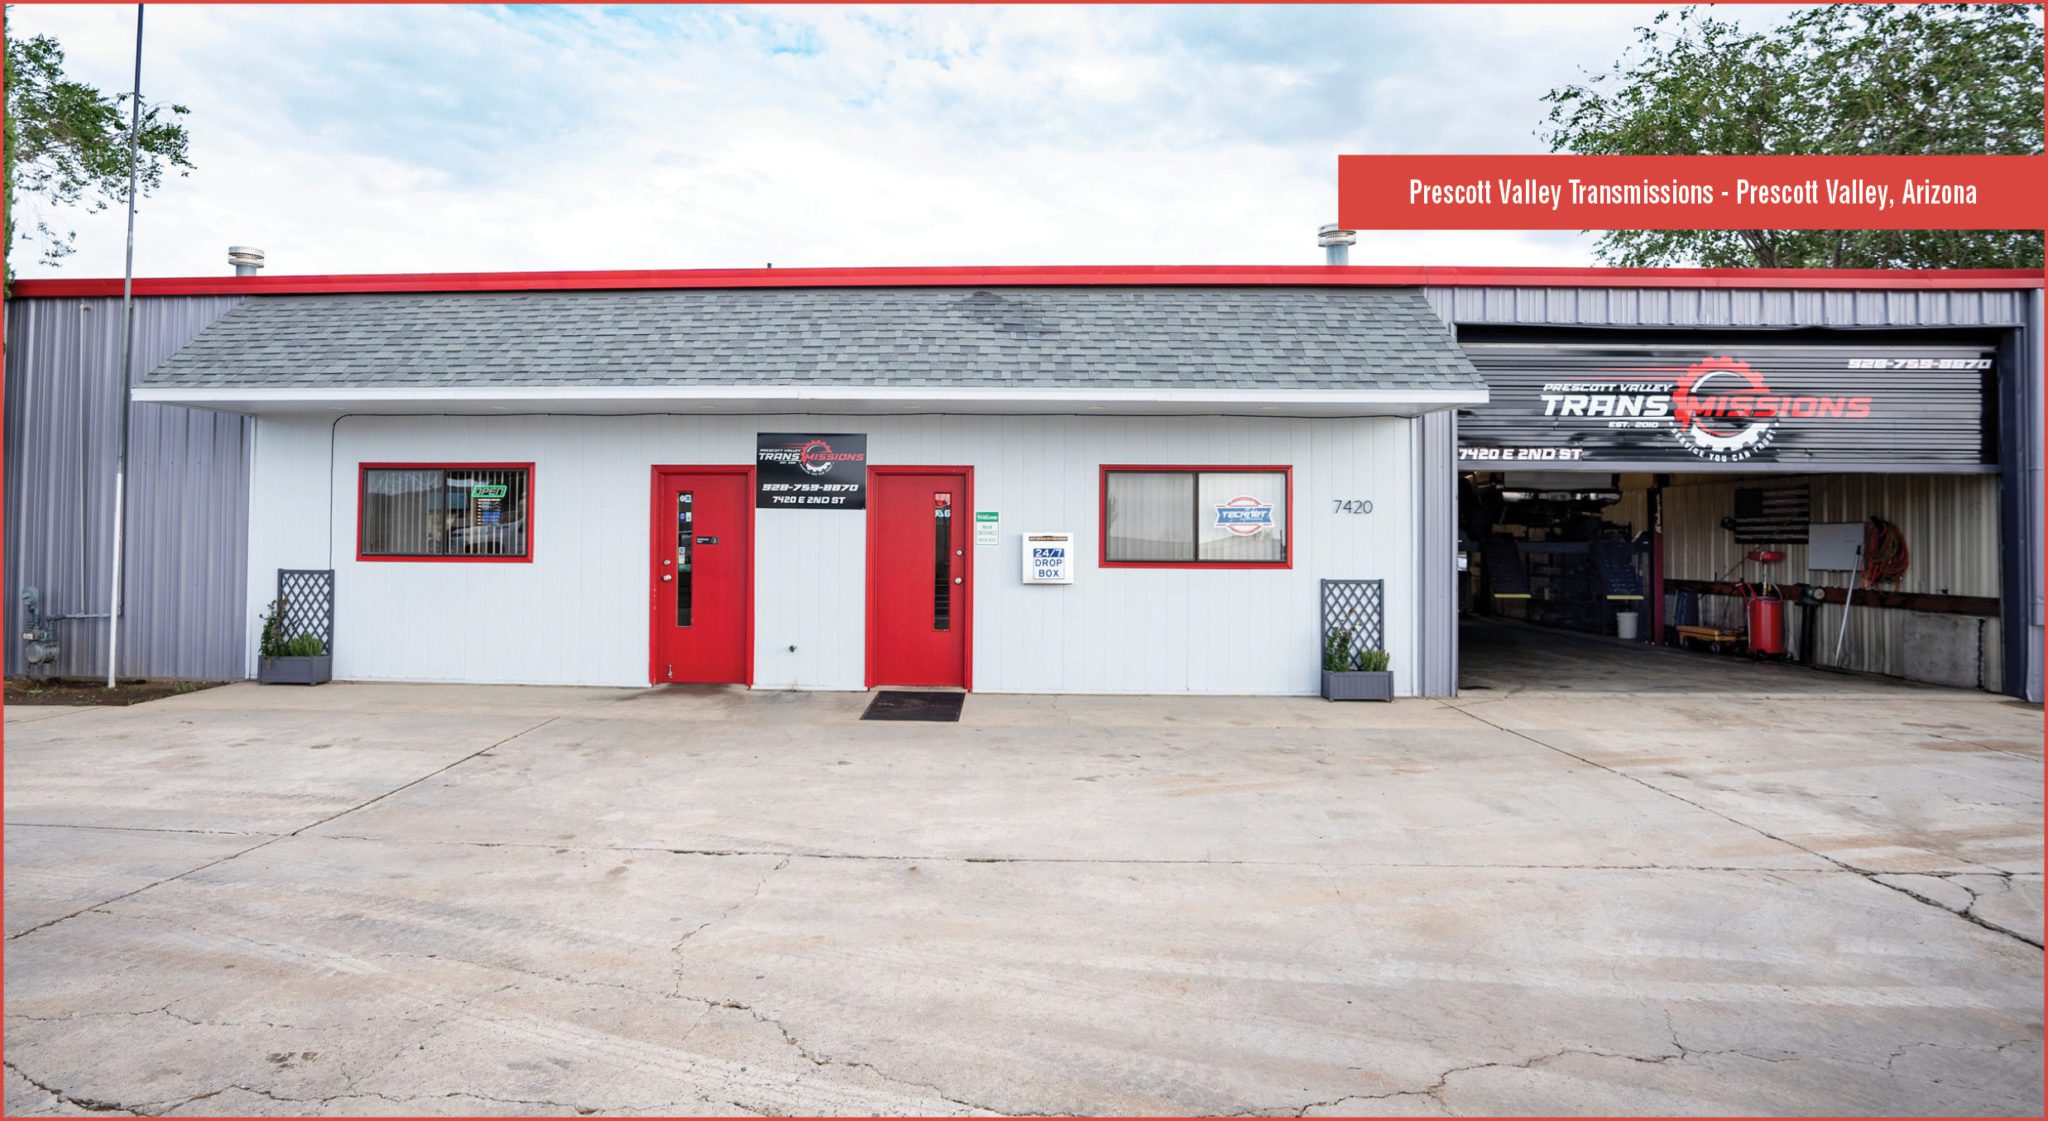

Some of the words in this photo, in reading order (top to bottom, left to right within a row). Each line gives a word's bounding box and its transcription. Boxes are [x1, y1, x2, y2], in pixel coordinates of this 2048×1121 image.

[1847, 358, 1993, 369] 928-759-8870
[1543, 383, 1617, 392] PRESCOTT
[1620, 383, 1673, 392] VALLEY
[1671, 428, 1706, 458] SERVICE
[1709, 453, 1727, 462] YOU
[1732, 450, 1751, 462] CAN
[1458, 448, 1500, 460] 7420
[1502, 448, 1515, 460] E
[1517, 448, 1556, 460] 2ND
[1558, 448, 1583, 460] ST
[475, 487, 504, 495] OPEN
[762, 483, 859, 492] 928-759-8870
[772, 496, 797, 504] 7420
[798, 496, 805, 504] E
[806, 496, 830, 504] 2ND
[831, 496, 846, 504] ST
[1333, 499, 1374, 514] 7420
[1035, 548, 1063, 557] 24/7
[1035, 558, 1063, 567] DROP
[1038, 569, 1059, 578] BOX
